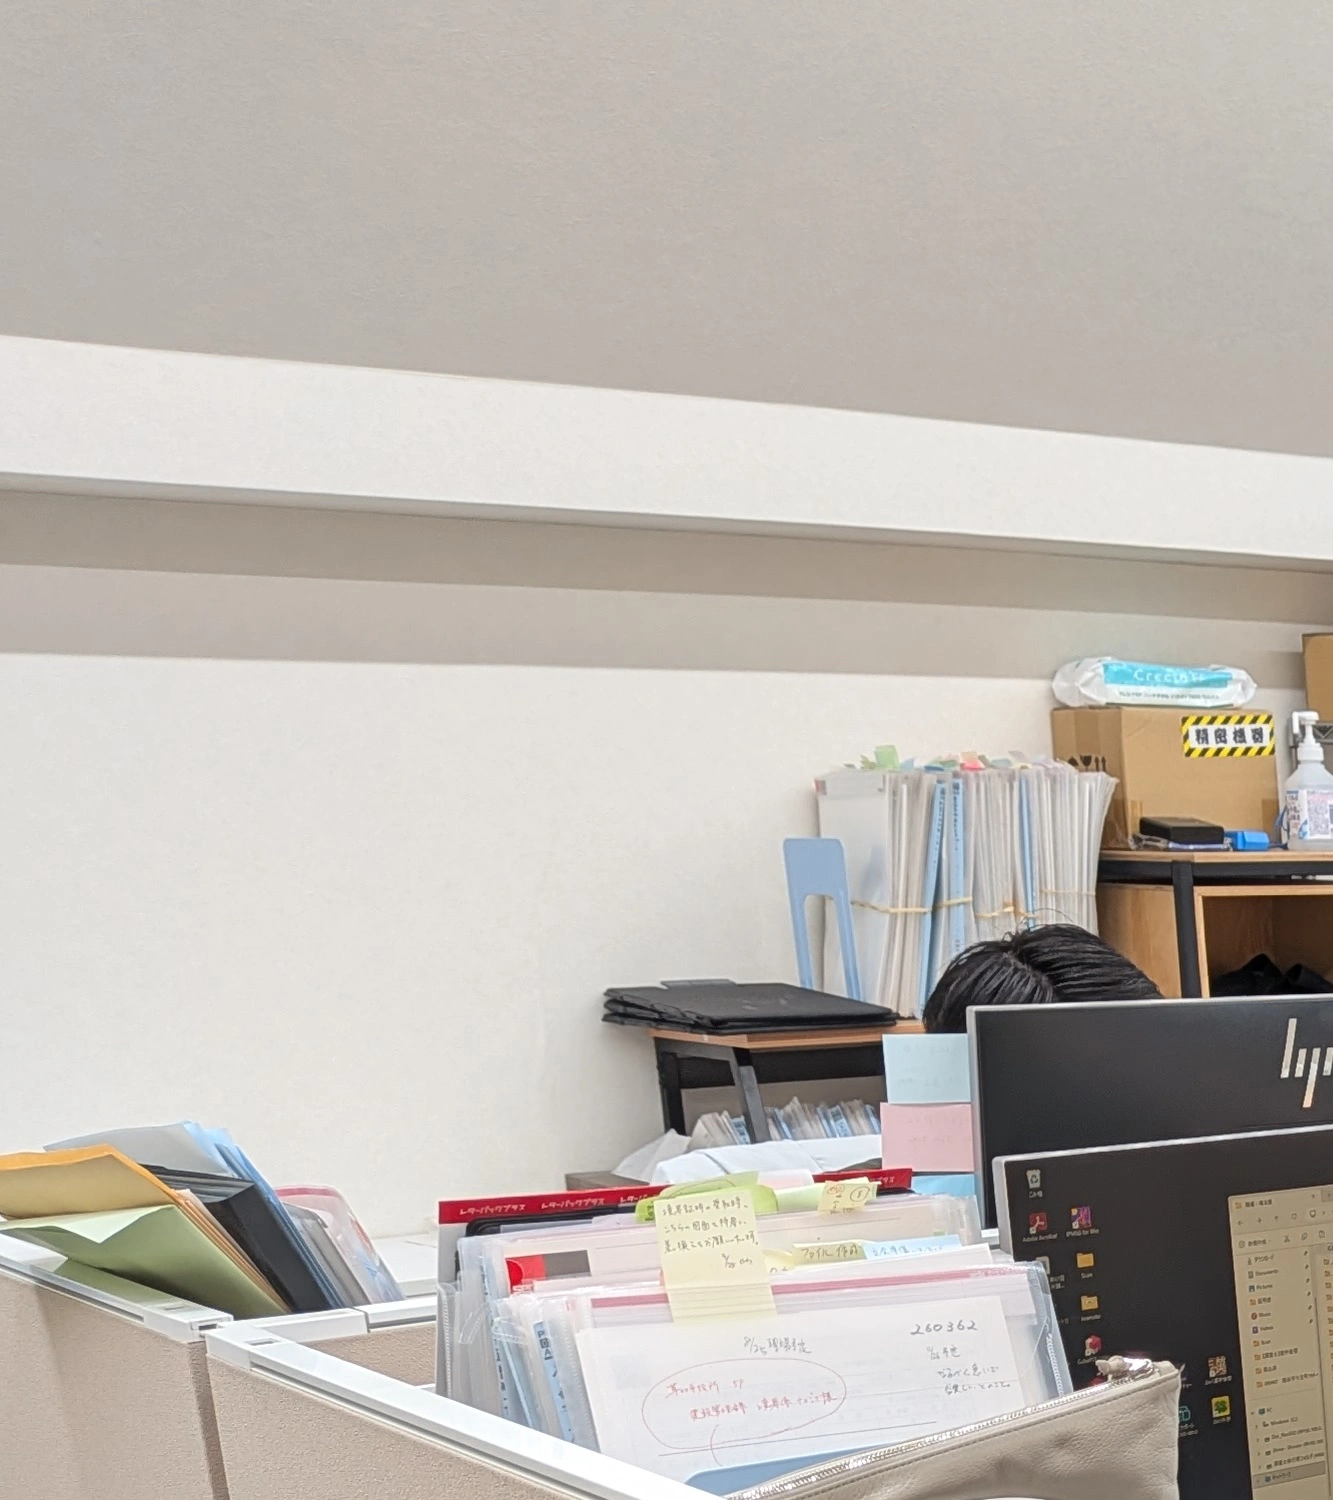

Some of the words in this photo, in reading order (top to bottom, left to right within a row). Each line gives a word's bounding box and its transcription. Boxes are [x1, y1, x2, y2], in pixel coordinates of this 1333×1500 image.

[1195, 727, 1264, 745] 精密機器
[459, 1204, 526, 1216] レターパックプラス
[910, 1320, 978, 1335] 260362
